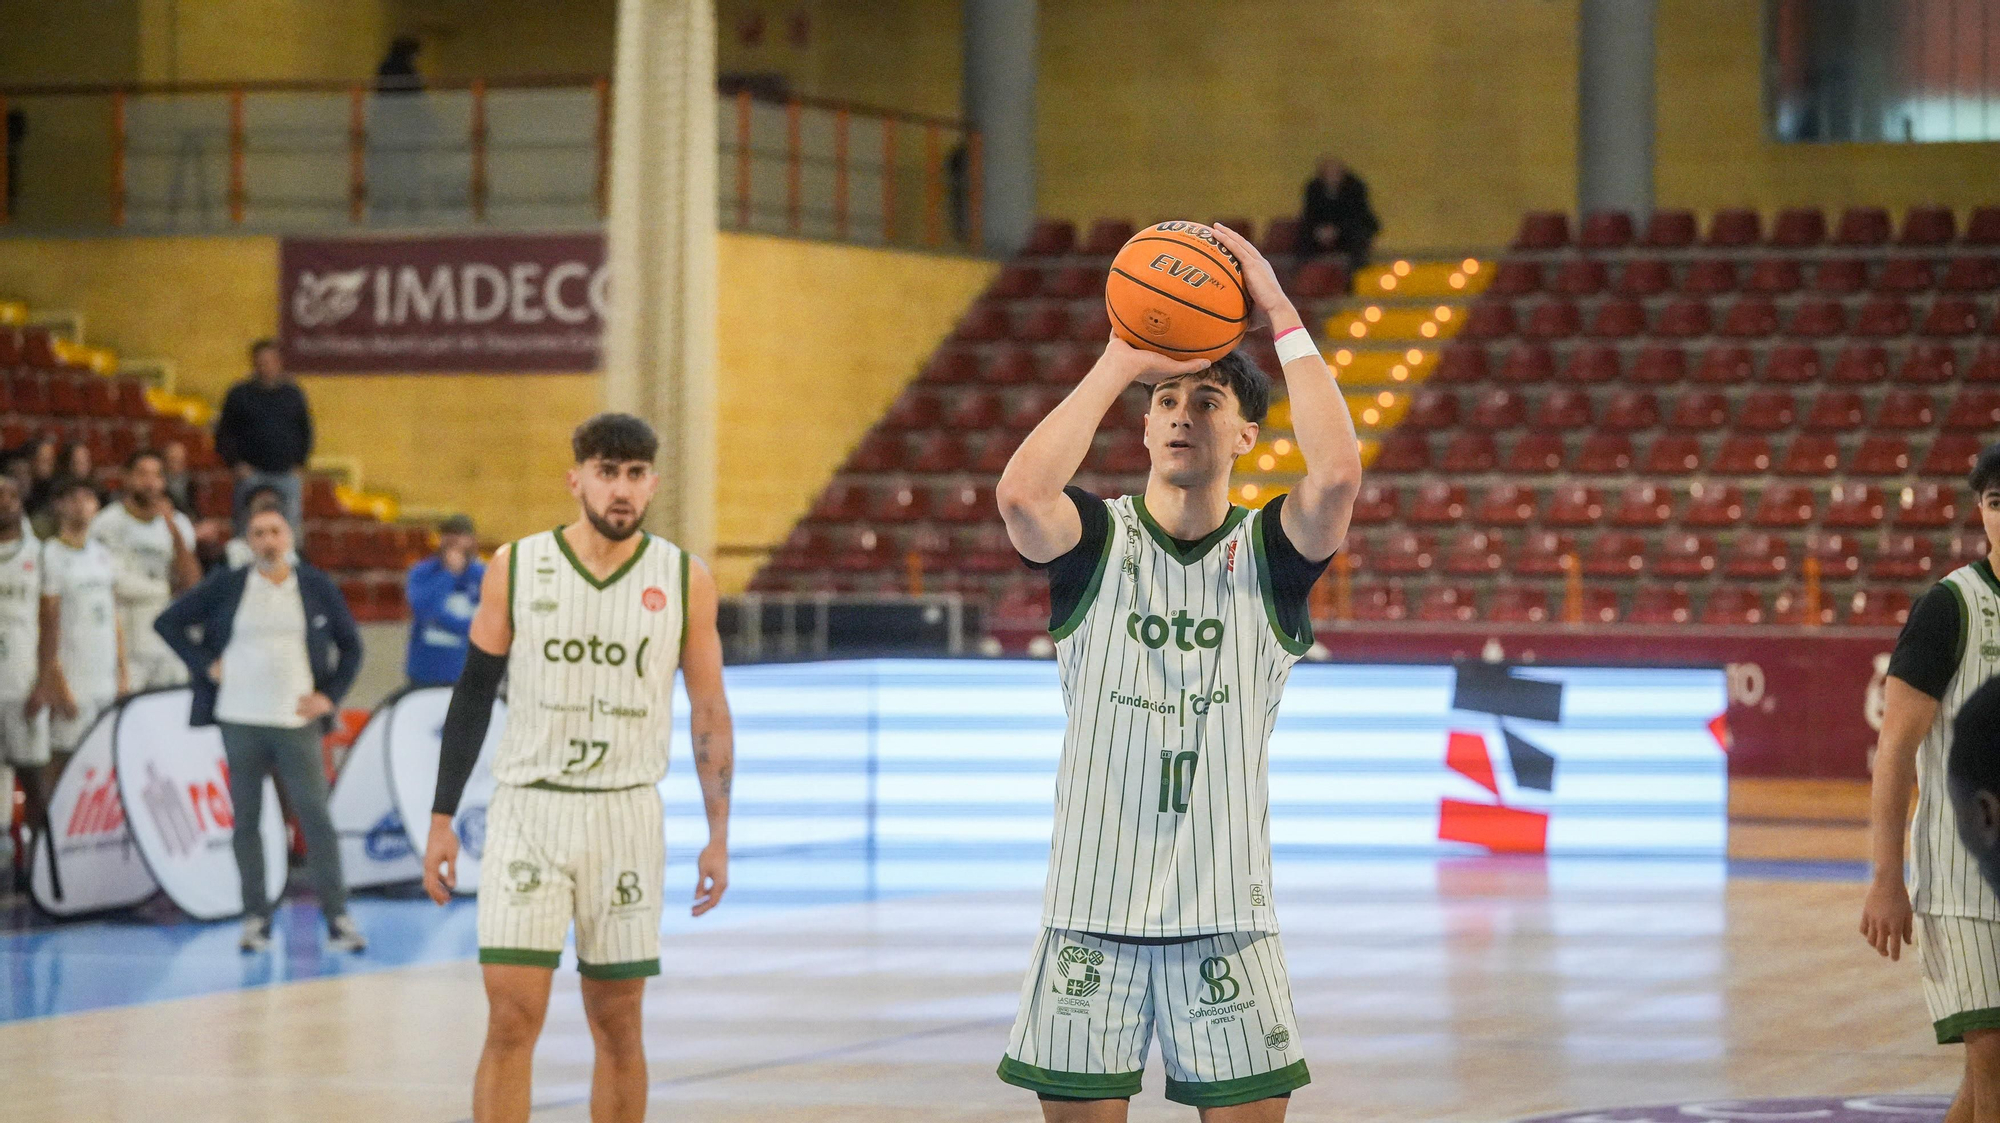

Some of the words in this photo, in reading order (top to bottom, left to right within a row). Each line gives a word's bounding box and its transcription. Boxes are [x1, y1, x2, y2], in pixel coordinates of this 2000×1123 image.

[1149, 253, 1211, 289] EVO
[1126, 609, 1225, 652] coto
[543, 635, 627, 667] coto
[1109, 690, 1176, 715] Fundación
[562, 738, 609, 775] 27
[1158, 750, 1199, 814] 10
[1210, 1015, 1236, 1026] HOTELS
